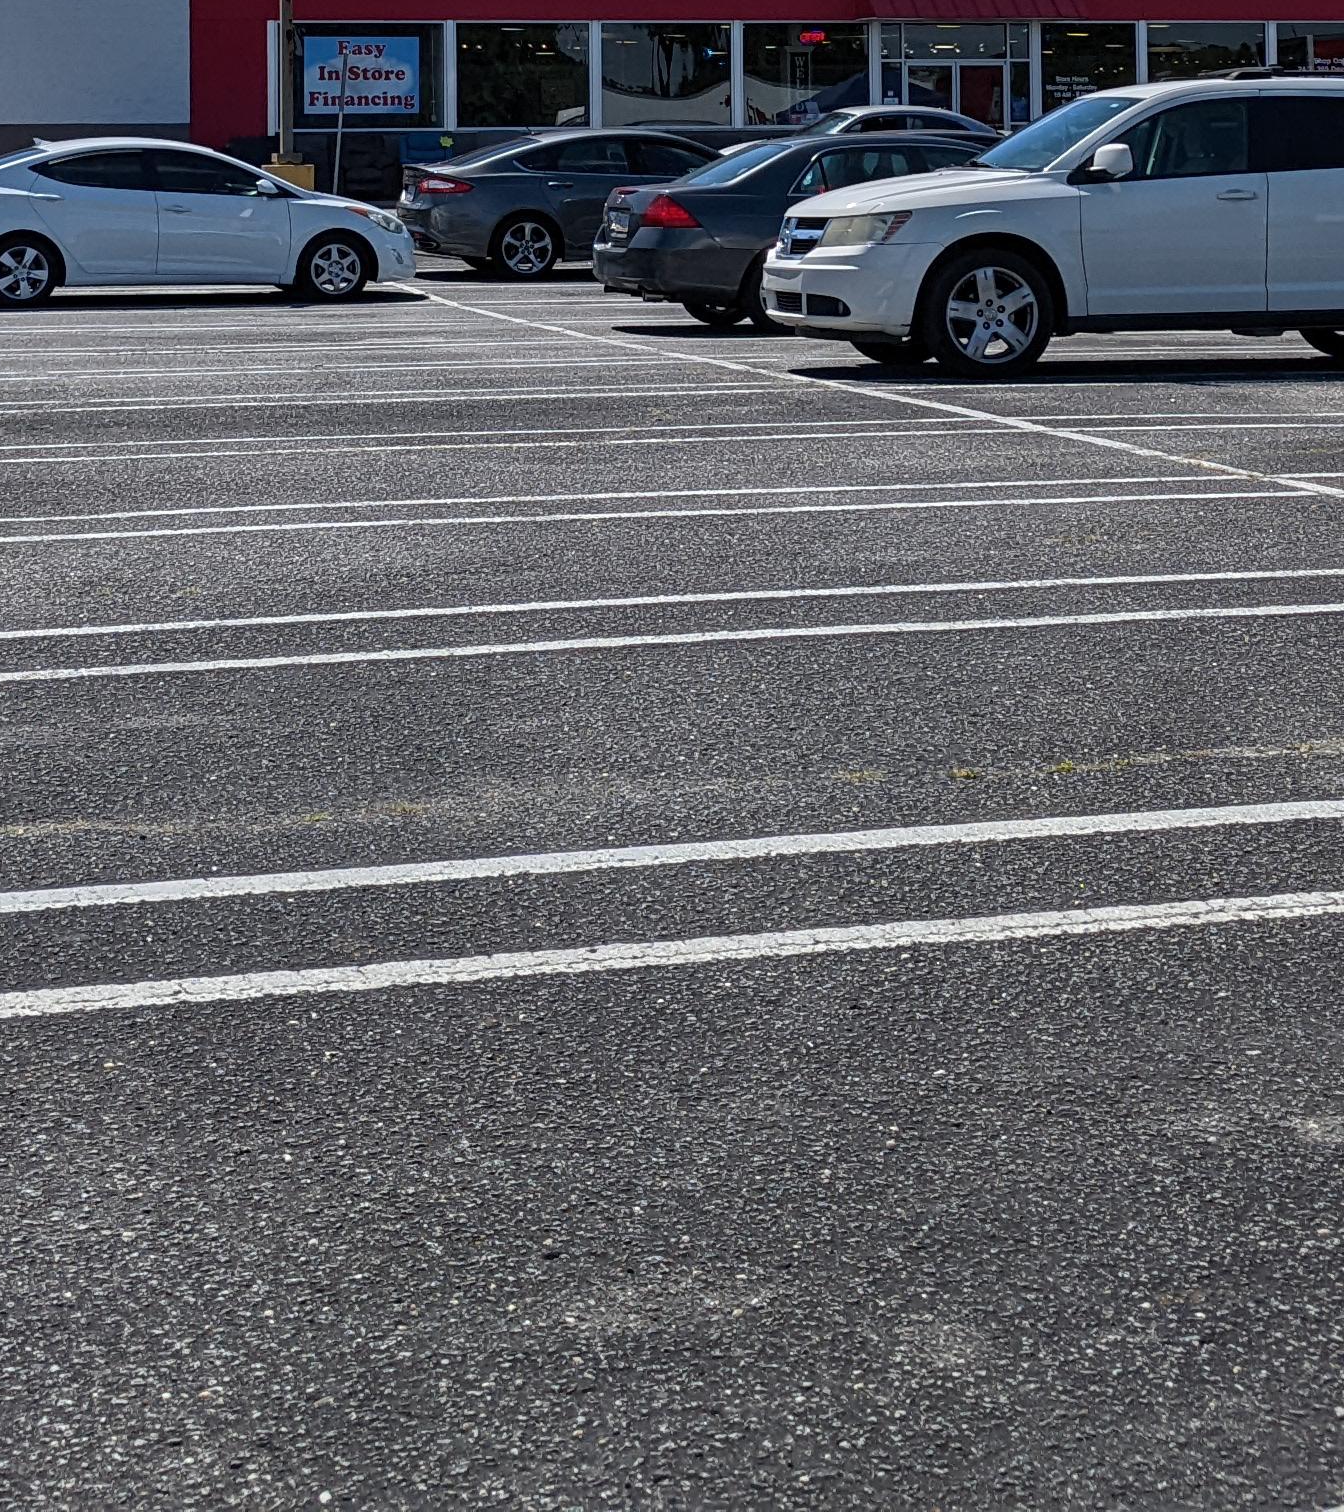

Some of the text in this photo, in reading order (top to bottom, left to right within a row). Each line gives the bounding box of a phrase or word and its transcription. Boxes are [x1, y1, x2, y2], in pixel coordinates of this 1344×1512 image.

[337, 40, 386, 58] Easy
[318, 65, 406, 81] In Store
[308, 91, 416, 110] Financing
